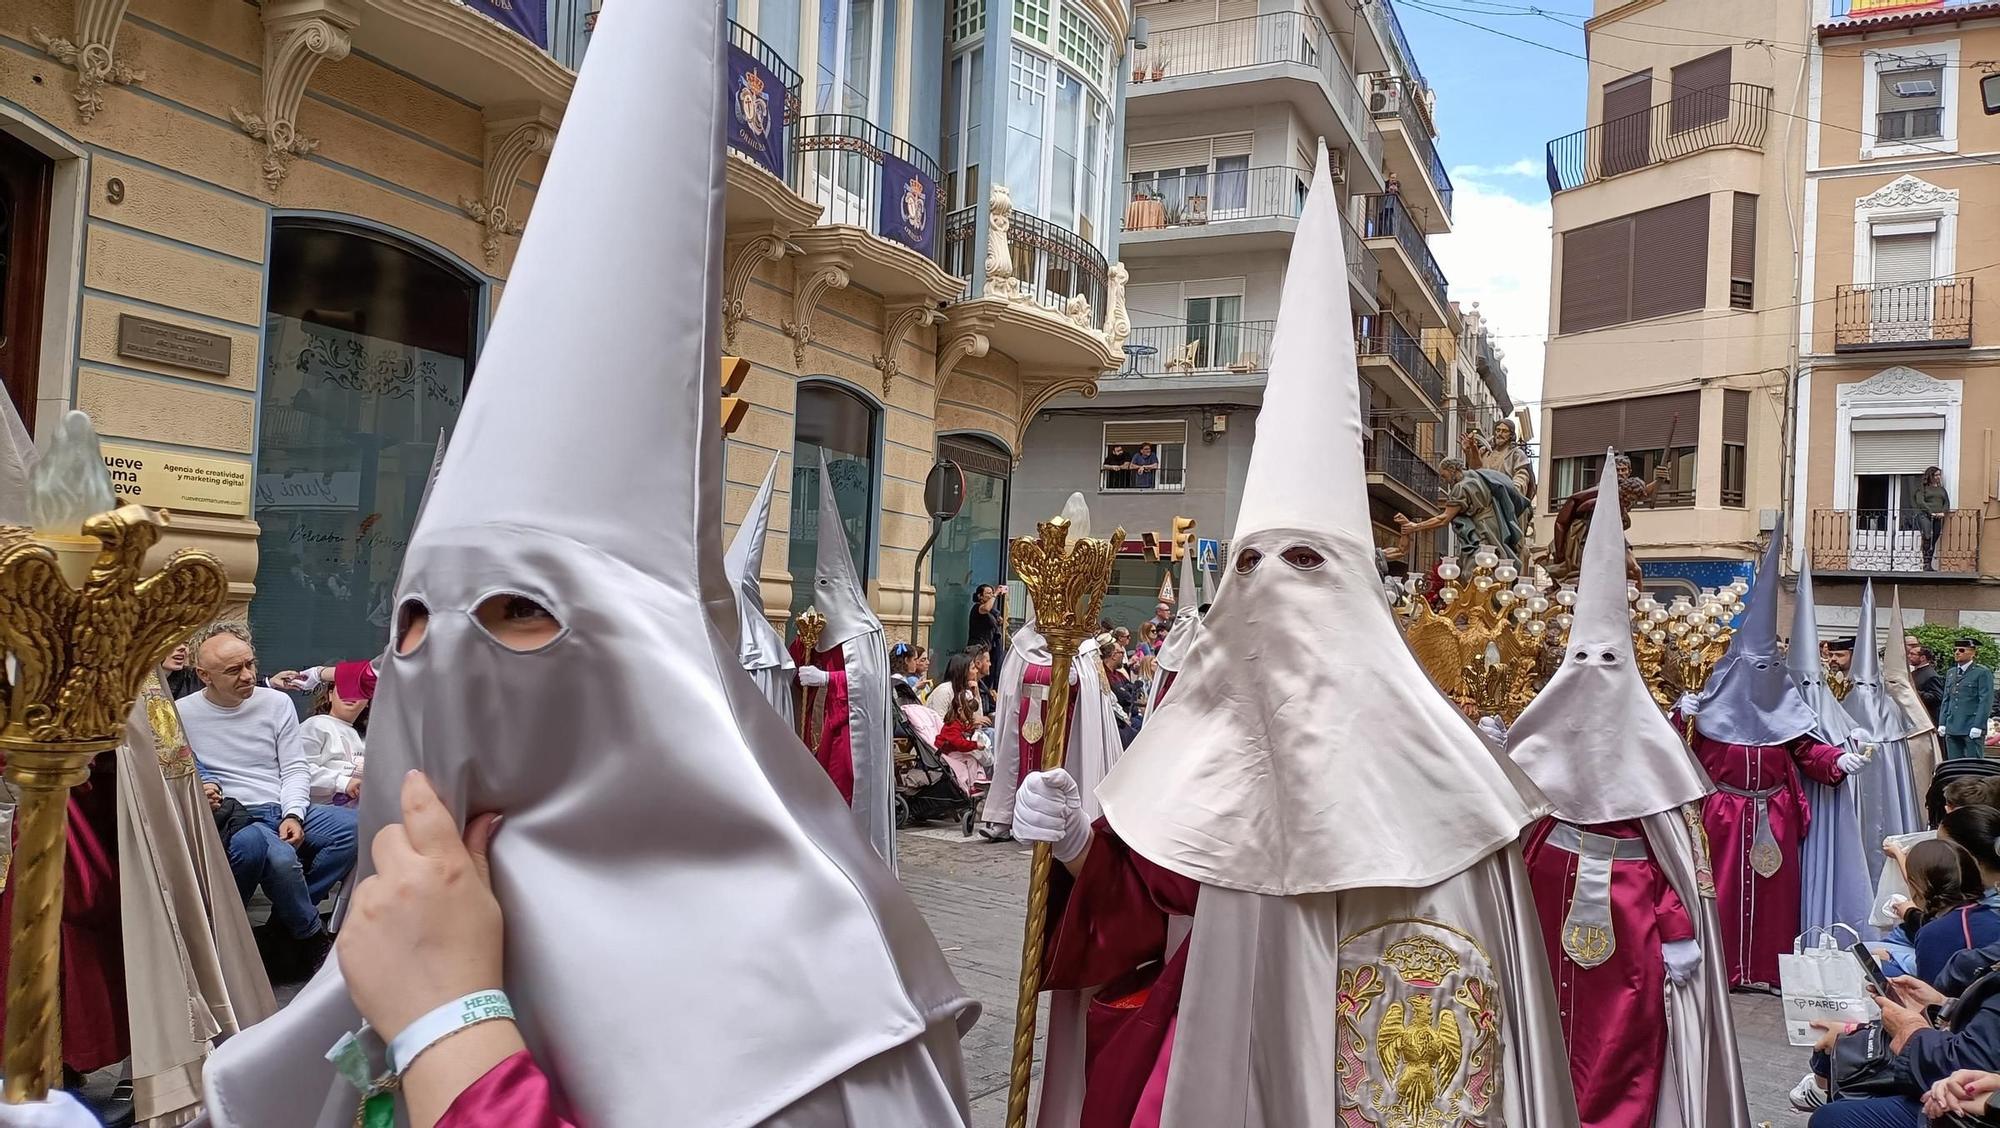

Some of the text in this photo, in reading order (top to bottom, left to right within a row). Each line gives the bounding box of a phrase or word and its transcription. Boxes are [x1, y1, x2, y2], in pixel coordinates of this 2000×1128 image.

[107, 177, 125, 205] 9
[104, 456, 143, 470] ueve
[109, 470, 138, 482] ma
[163, 464, 245, 480] Agencia de creatividad
[183, 474, 221, 486] marketing
[222, 479, 245, 487] digital
[113, 483, 142, 496] eve
[1808, 999, 1849, 1011] PAREJO
[462, 1010, 482, 1024] EL
